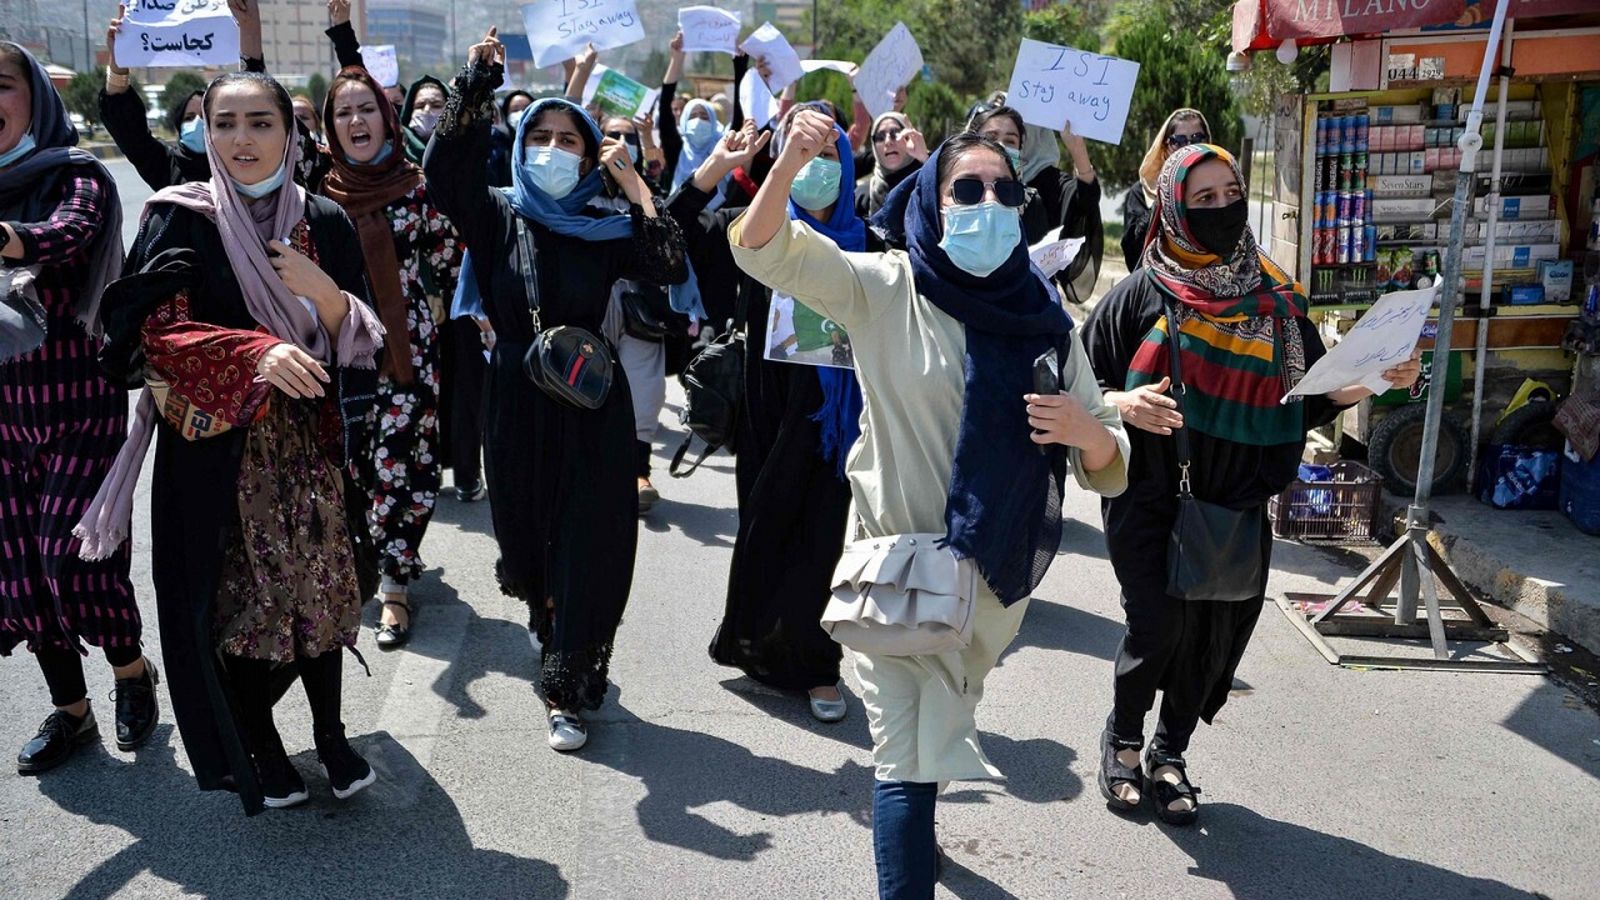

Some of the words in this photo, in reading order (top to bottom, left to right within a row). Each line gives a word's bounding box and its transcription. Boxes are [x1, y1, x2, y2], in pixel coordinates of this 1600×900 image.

[599, 11, 635, 28] away
[141, 32, 215, 56] کجاست؟
[1041, 46, 1118, 86] ISI
[1067, 91, 1111, 122] away
